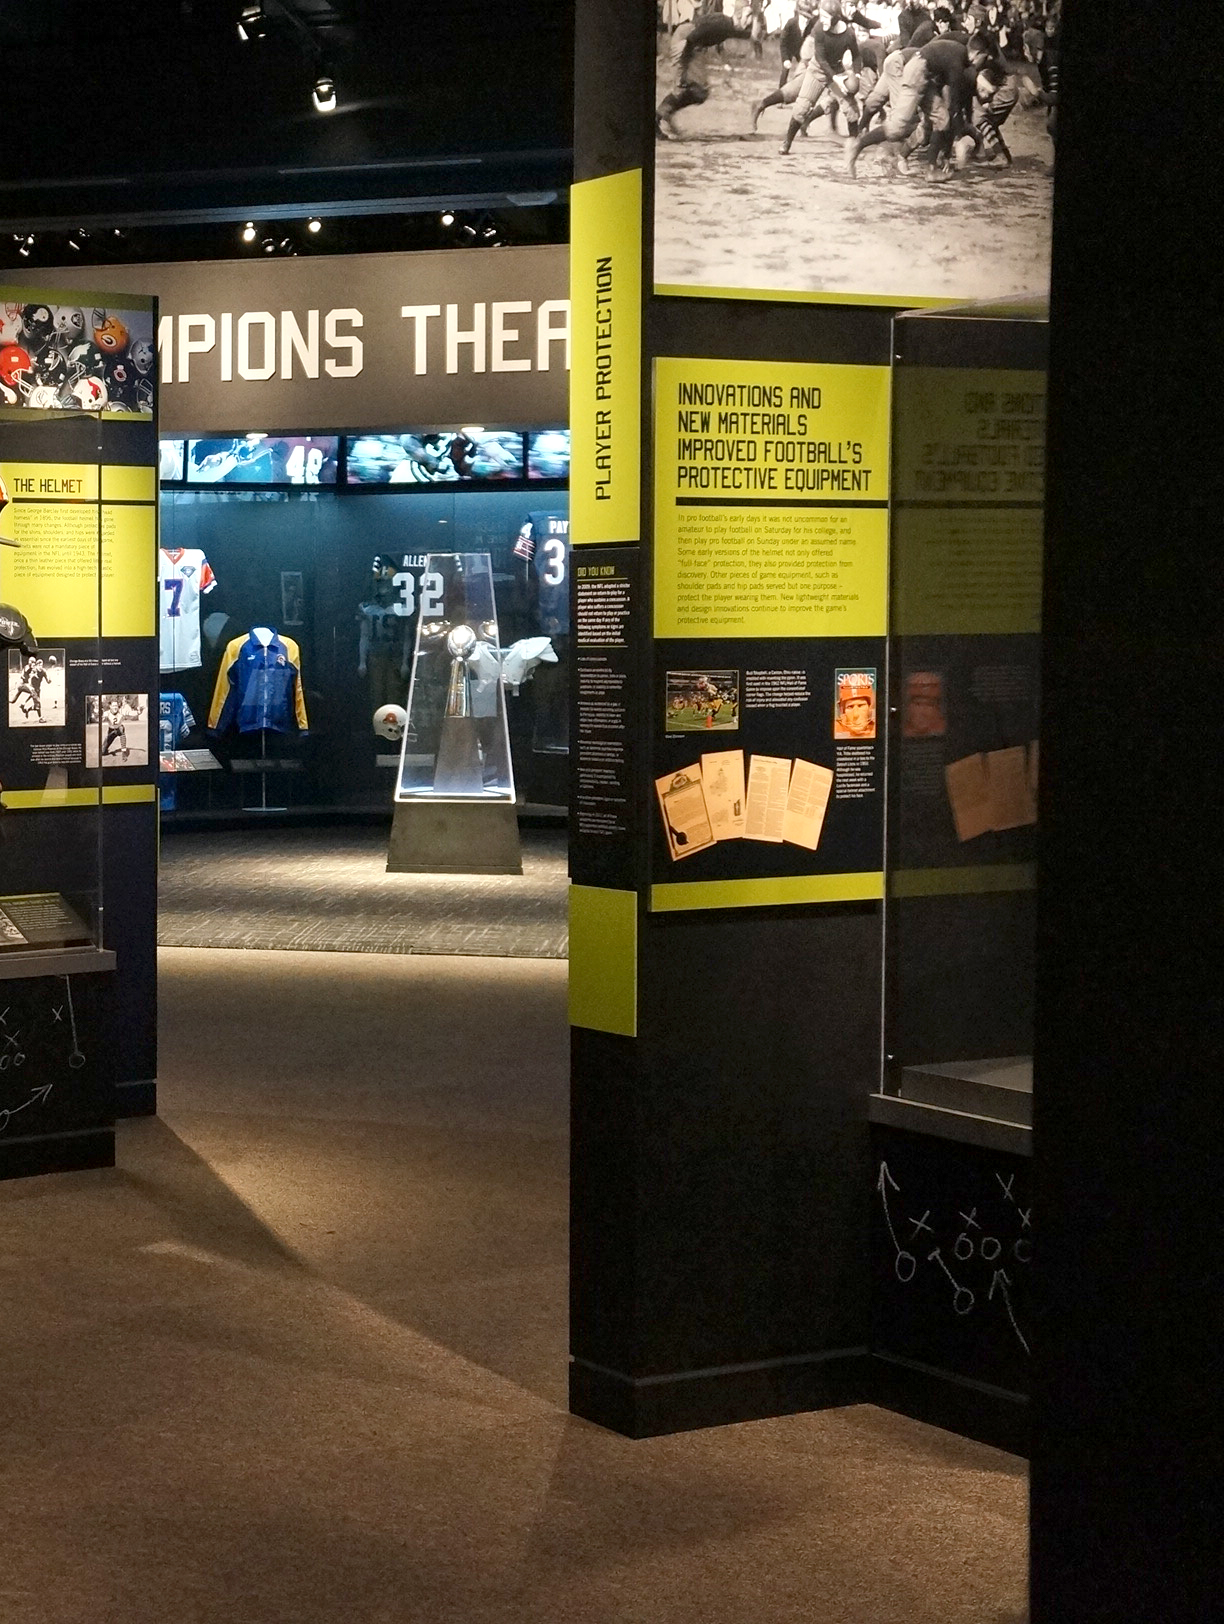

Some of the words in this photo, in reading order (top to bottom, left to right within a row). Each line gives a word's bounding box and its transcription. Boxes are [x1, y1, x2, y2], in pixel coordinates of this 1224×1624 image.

[596, 257, 612, 400] PROTECTION
[679, 383, 782, 408] INNOVATIONS
[790, 387, 821, 408] AND
[678, 411, 710, 432] NEW
[718, 412, 807, 435] MATERIALS
[596, 410, 611, 500] PLAYER
[678, 438, 756, 461] IMPROVED
[764, 440, 862, 464] FOOTBALL'S
[14, 478, 35, 492] THE
[40, 479, 83, 493] HELMET
[678, 466, 778, 489] PROTECTIVE
[785, 468, 872, 492] EQUIPMENT
[730, 515, 744, 523] early
[747, 515, 760, 523] days
[550, 520, 569, 534] PAY
[714, 526, 726, 535] play
[764, 527, 791, 535] Saturday
[694, 538, 707, 546] play
[757, 538, 780, 546] Sunday
[698, 549, 712, 557] early
[797, 549, 810, 558] only
[588, 566, 598, 576] YOU
[707, 583, 721, 591] pads
[737, 583, 747, 591] hip
[750, 583, 764, 591] pads
[164, 579, 184, 618] 7
[392, 572, 444, 617] 32
[678, 594, 700, 602] protect
[714, 594, 732, 602] player
[735, 594, 758, 602] wearing
[837, 674, 875, 686] SPORTS
